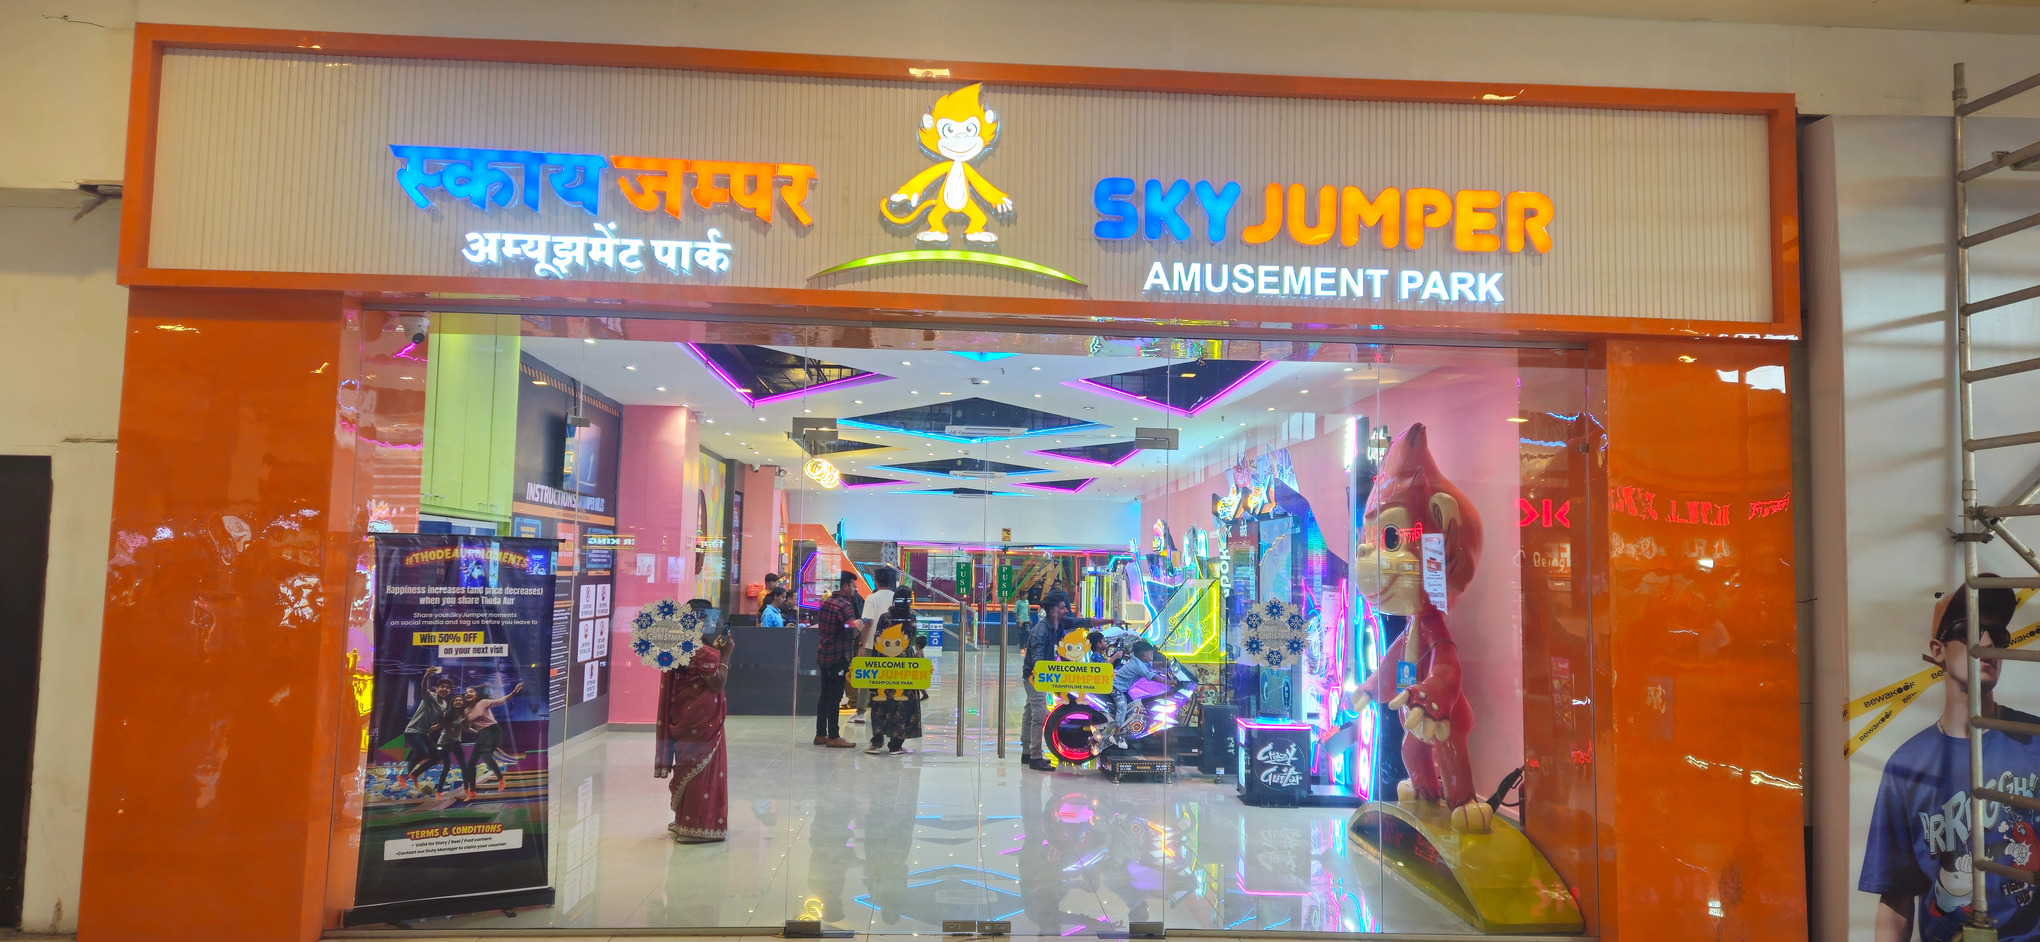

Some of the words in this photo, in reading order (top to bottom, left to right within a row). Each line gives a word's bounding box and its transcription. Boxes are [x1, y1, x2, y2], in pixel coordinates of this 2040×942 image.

[461, 222, 645, 279] अम्यूझमेंट
[650, 227, 734, 275] पार्क
[1142, 260, 1389, 299] AMUSEMENT
[1399, 269, 1505, 303] PARK
[526, 481, 577, 508] INSTRUCTIONS
[959, 563, 967, 594] PUSH
[1001, 566, 1009, 598] PUSH
[386, 585, 426, 595] Happiness
[428, 586, 466, 595] increases
[467, 585, 484, 595] (and
[485, 586, 503, 596] price
[504, 586, 544, 596] decreases)
[419, 597, 441, 605] when
[441, 598, 456, 607] you
[457, 597, 480, 605] share
[481, 597, 501, 605] Thoda
[502, 597, 515, 605] Aur
[450, 612, 488, 620] SkyJumper
[459, 619, 471, 627] tag
[419, 633, 436, 643] Win
[438, 633, 461, 643] 50%
[463, 632, 478, 643] OFF
[443, 647, 453, 655] on
[454, 646, 471, 656] your
[472, 646, 488, 655] next
[489, 645, 504, 654] visit
[865, 661, 905, 669] WELCOME
[908, 661, 919, 669] TO
[1047, 665, 1087, 673] WELCOME
[1089, 665, 1101, 673] TO
[442, 827, 449, 836] &
[451, 823, 502, 836] CONDITIONS
